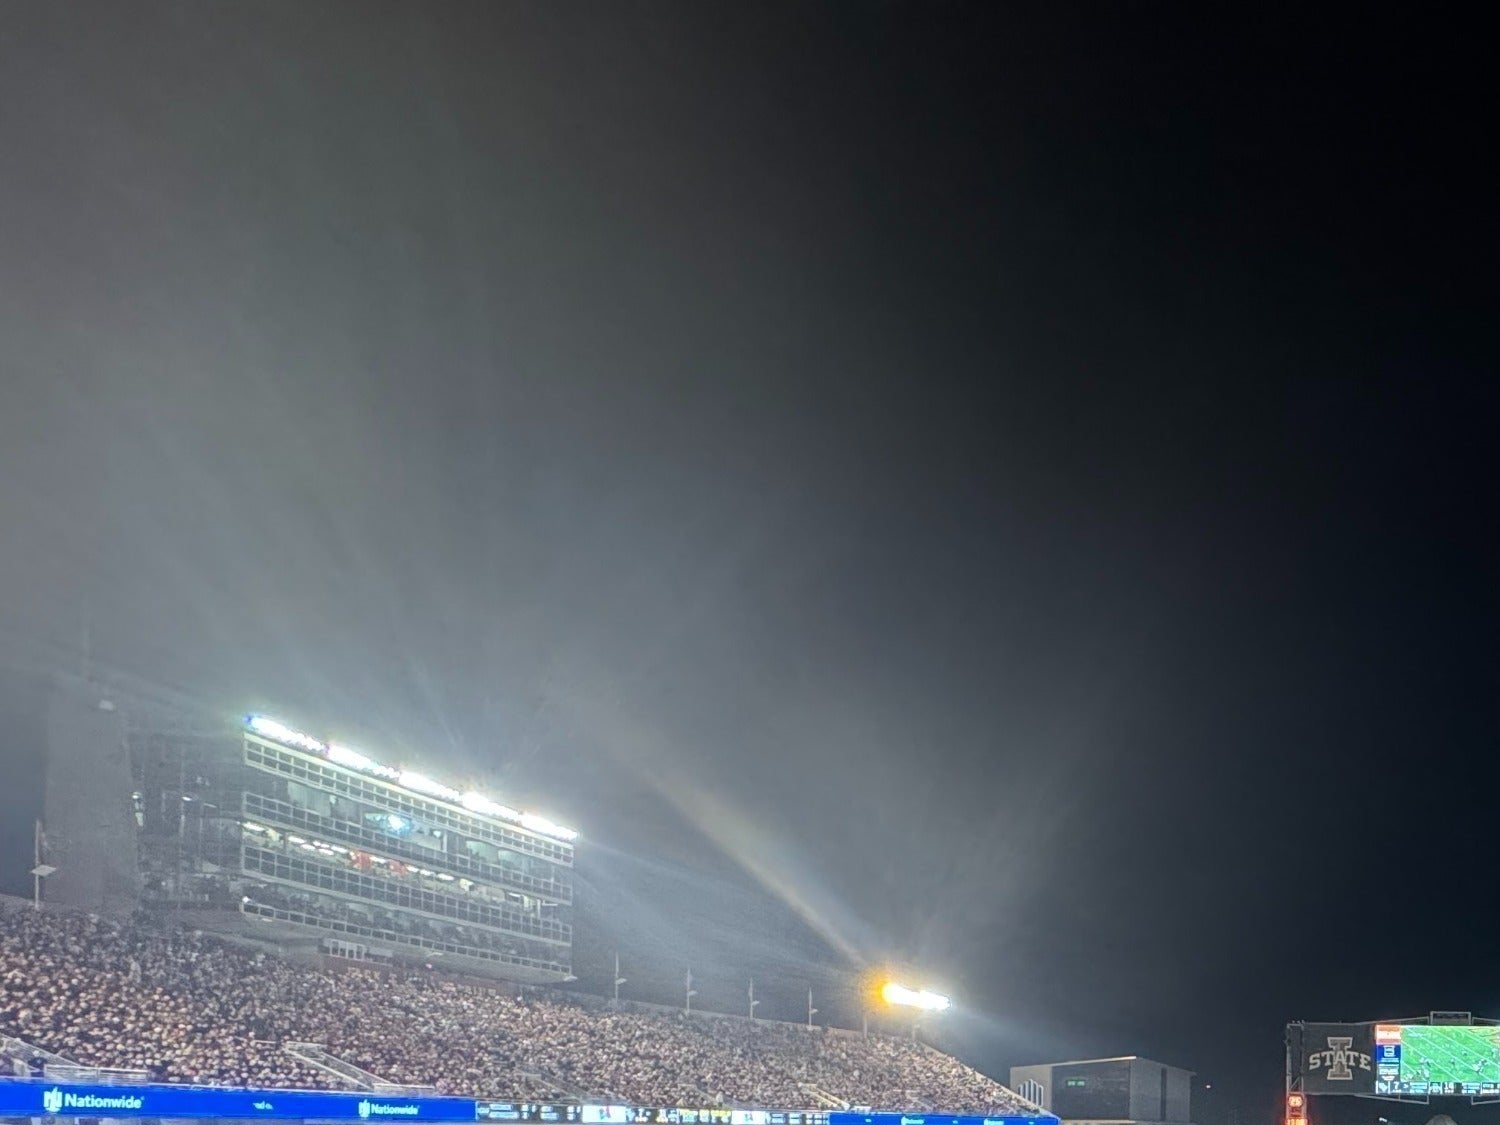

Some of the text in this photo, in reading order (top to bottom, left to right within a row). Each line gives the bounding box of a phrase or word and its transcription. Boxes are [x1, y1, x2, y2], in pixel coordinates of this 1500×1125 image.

[1309, 1051, 1371, 1070] STATE
[64, 1094, 142, 1109] Nationwide
[371, 1104, 418, 1114] Nationwide
